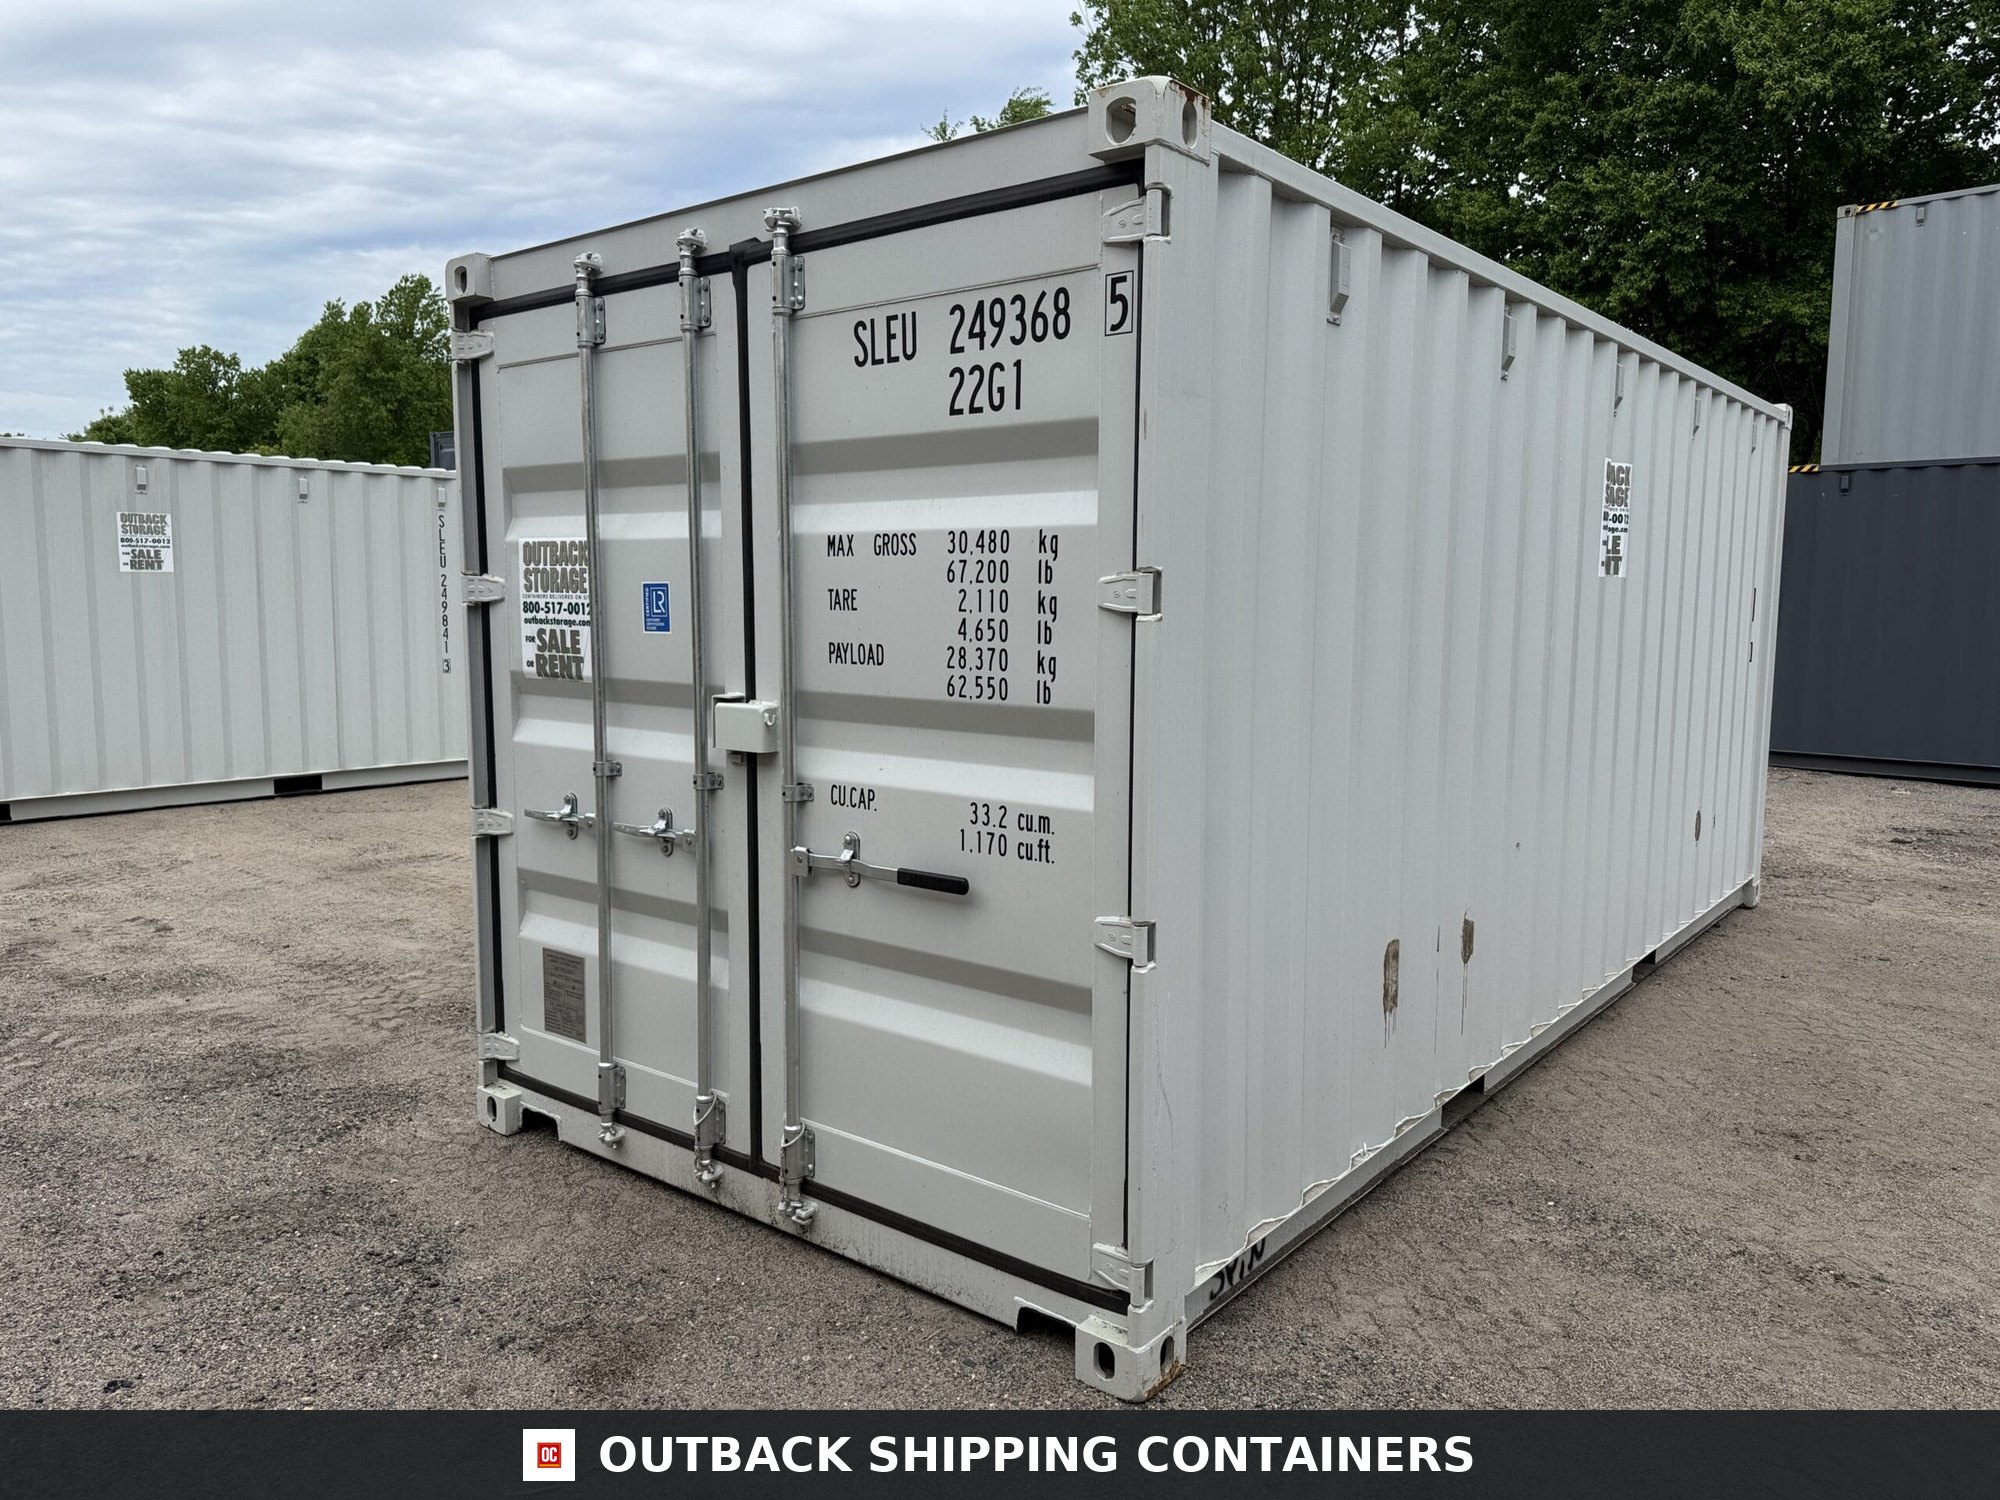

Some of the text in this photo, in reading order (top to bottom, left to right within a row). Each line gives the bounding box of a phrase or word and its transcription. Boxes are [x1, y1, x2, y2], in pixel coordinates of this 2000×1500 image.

[854, 275, 1128, 367] SLEU 249368 5
[948, 359, 1022, 416] 22G1
[120, 513, 168, 525] OUTBACK
[121, 524, 167, 535] STORAGE
[131, 549, 161, 559] SALE
[522, 540, 590, 567] OUTBACK
[827, 529, 1059, 561] MAX GROSS 30,480 kg
[130, 560, 164, 570] RENT
[947, 559, 1053, 585] 67,200 lb
[438, 514, 450, 672] SLEU 249841 3
[523, 567, 588, 594] STORAGE
[828, 588, 1058, 622] TARE 2,110 kg
[536, 628, 581, 655] SALE
[958, 618, 1052, 644] 4,650 lb
[526, 654, 584, 680] OR RENT
[828, 642, 1057, 682] PAYLOAD 28,370 kg
[946, 675, 1051, 705] 62,550 lb
[830, 784, 877, 812] CU.CAP.
[970, 802, 1055, 835] 33.2 cu.m.
[960, 828, 1055, 864] 1,170 cu.ft.
